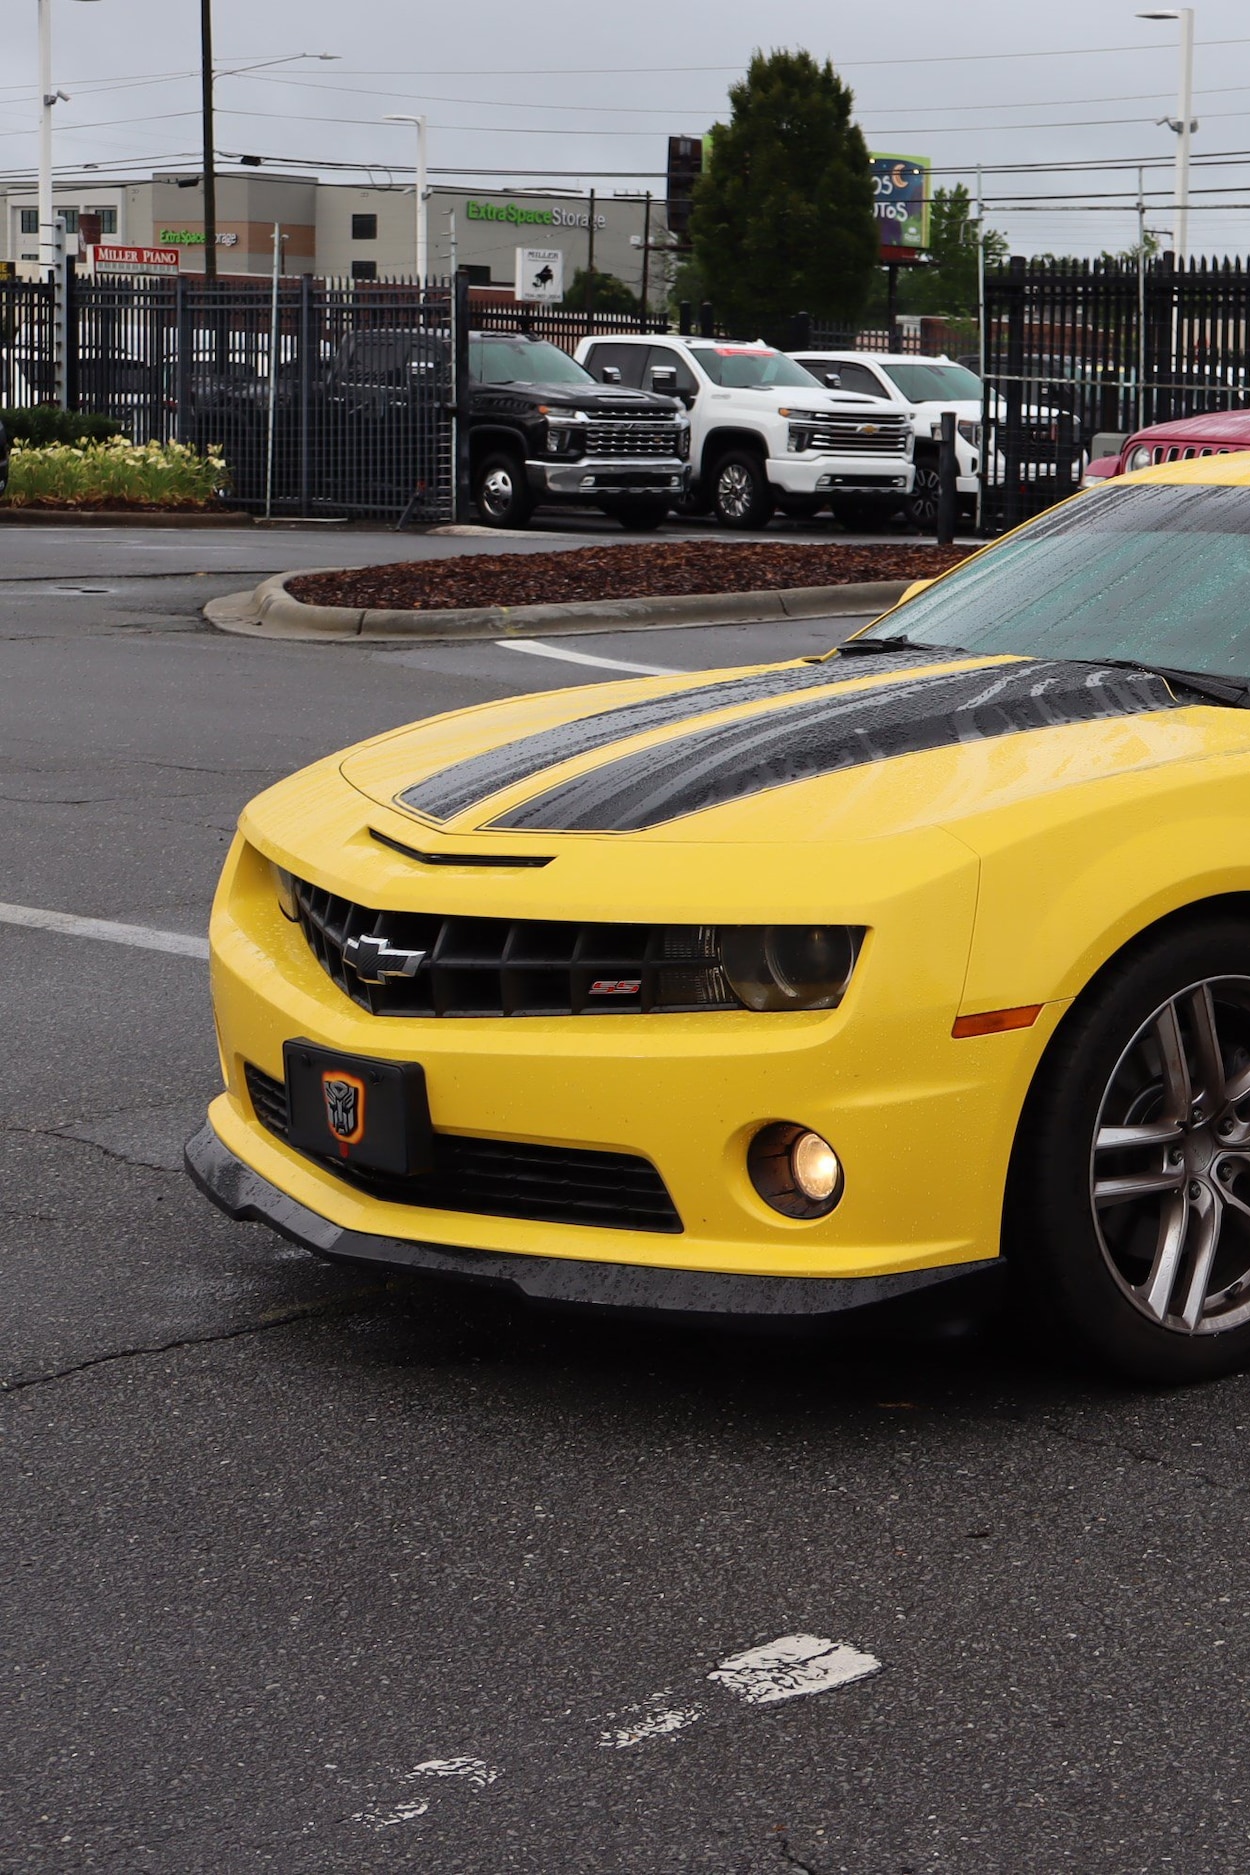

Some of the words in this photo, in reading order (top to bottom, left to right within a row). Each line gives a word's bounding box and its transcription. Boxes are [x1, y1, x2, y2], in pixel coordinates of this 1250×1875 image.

[98, 247, 138, 263] MILLER
[143, 250, 176, 264] PIANO
[588, 980, 642, 994] SS
